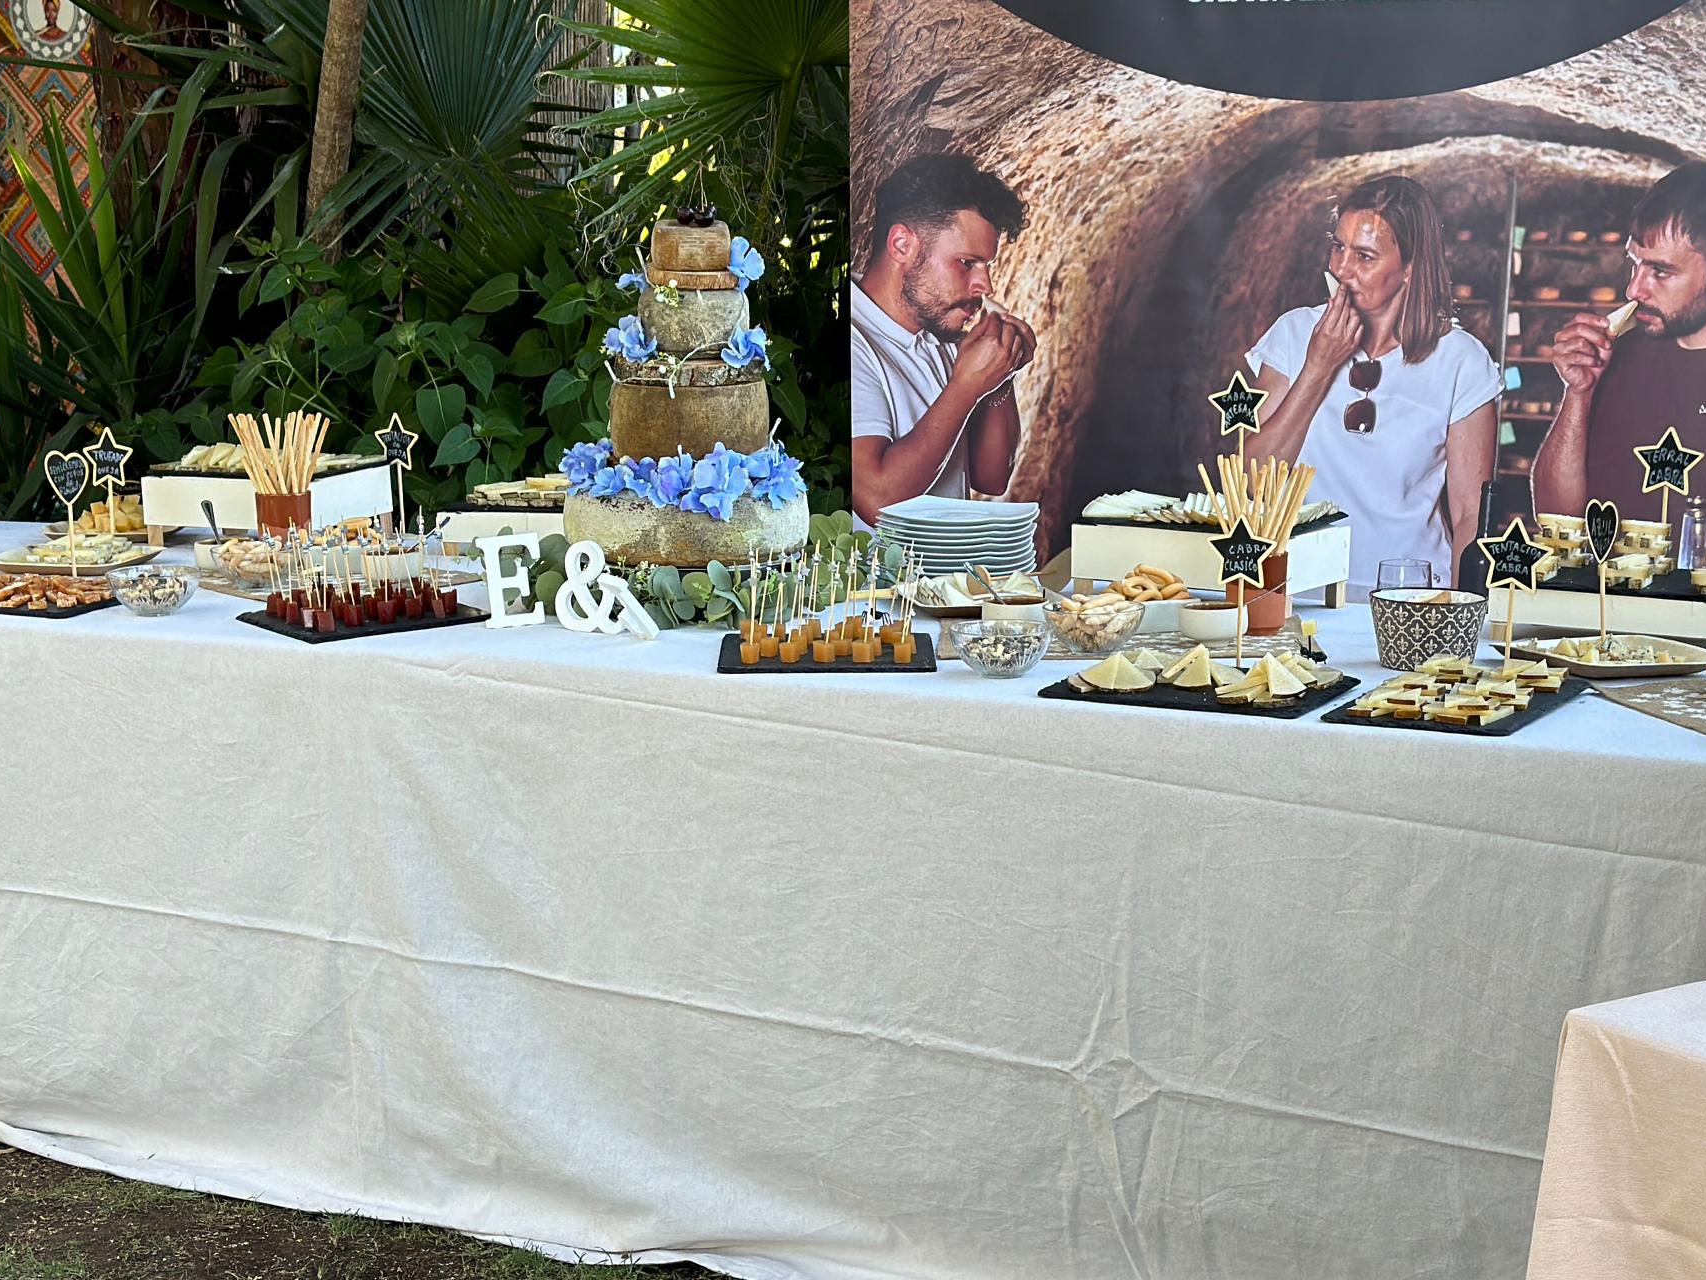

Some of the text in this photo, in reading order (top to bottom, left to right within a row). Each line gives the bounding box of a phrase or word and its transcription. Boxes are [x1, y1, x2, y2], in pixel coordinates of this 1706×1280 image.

[1221, 391, 1253, 403] CABRA
[1643, 447, 1690, 466] TERRAL
[1649, 467, 1685, 489] CABRA
[1228, 543, 1267, 555] CABRA
[1489, 540, 1543, 560] TENTACION
[1506, 551, 1521, 562] de
[1495, 561, 1529, 575] CABRA
